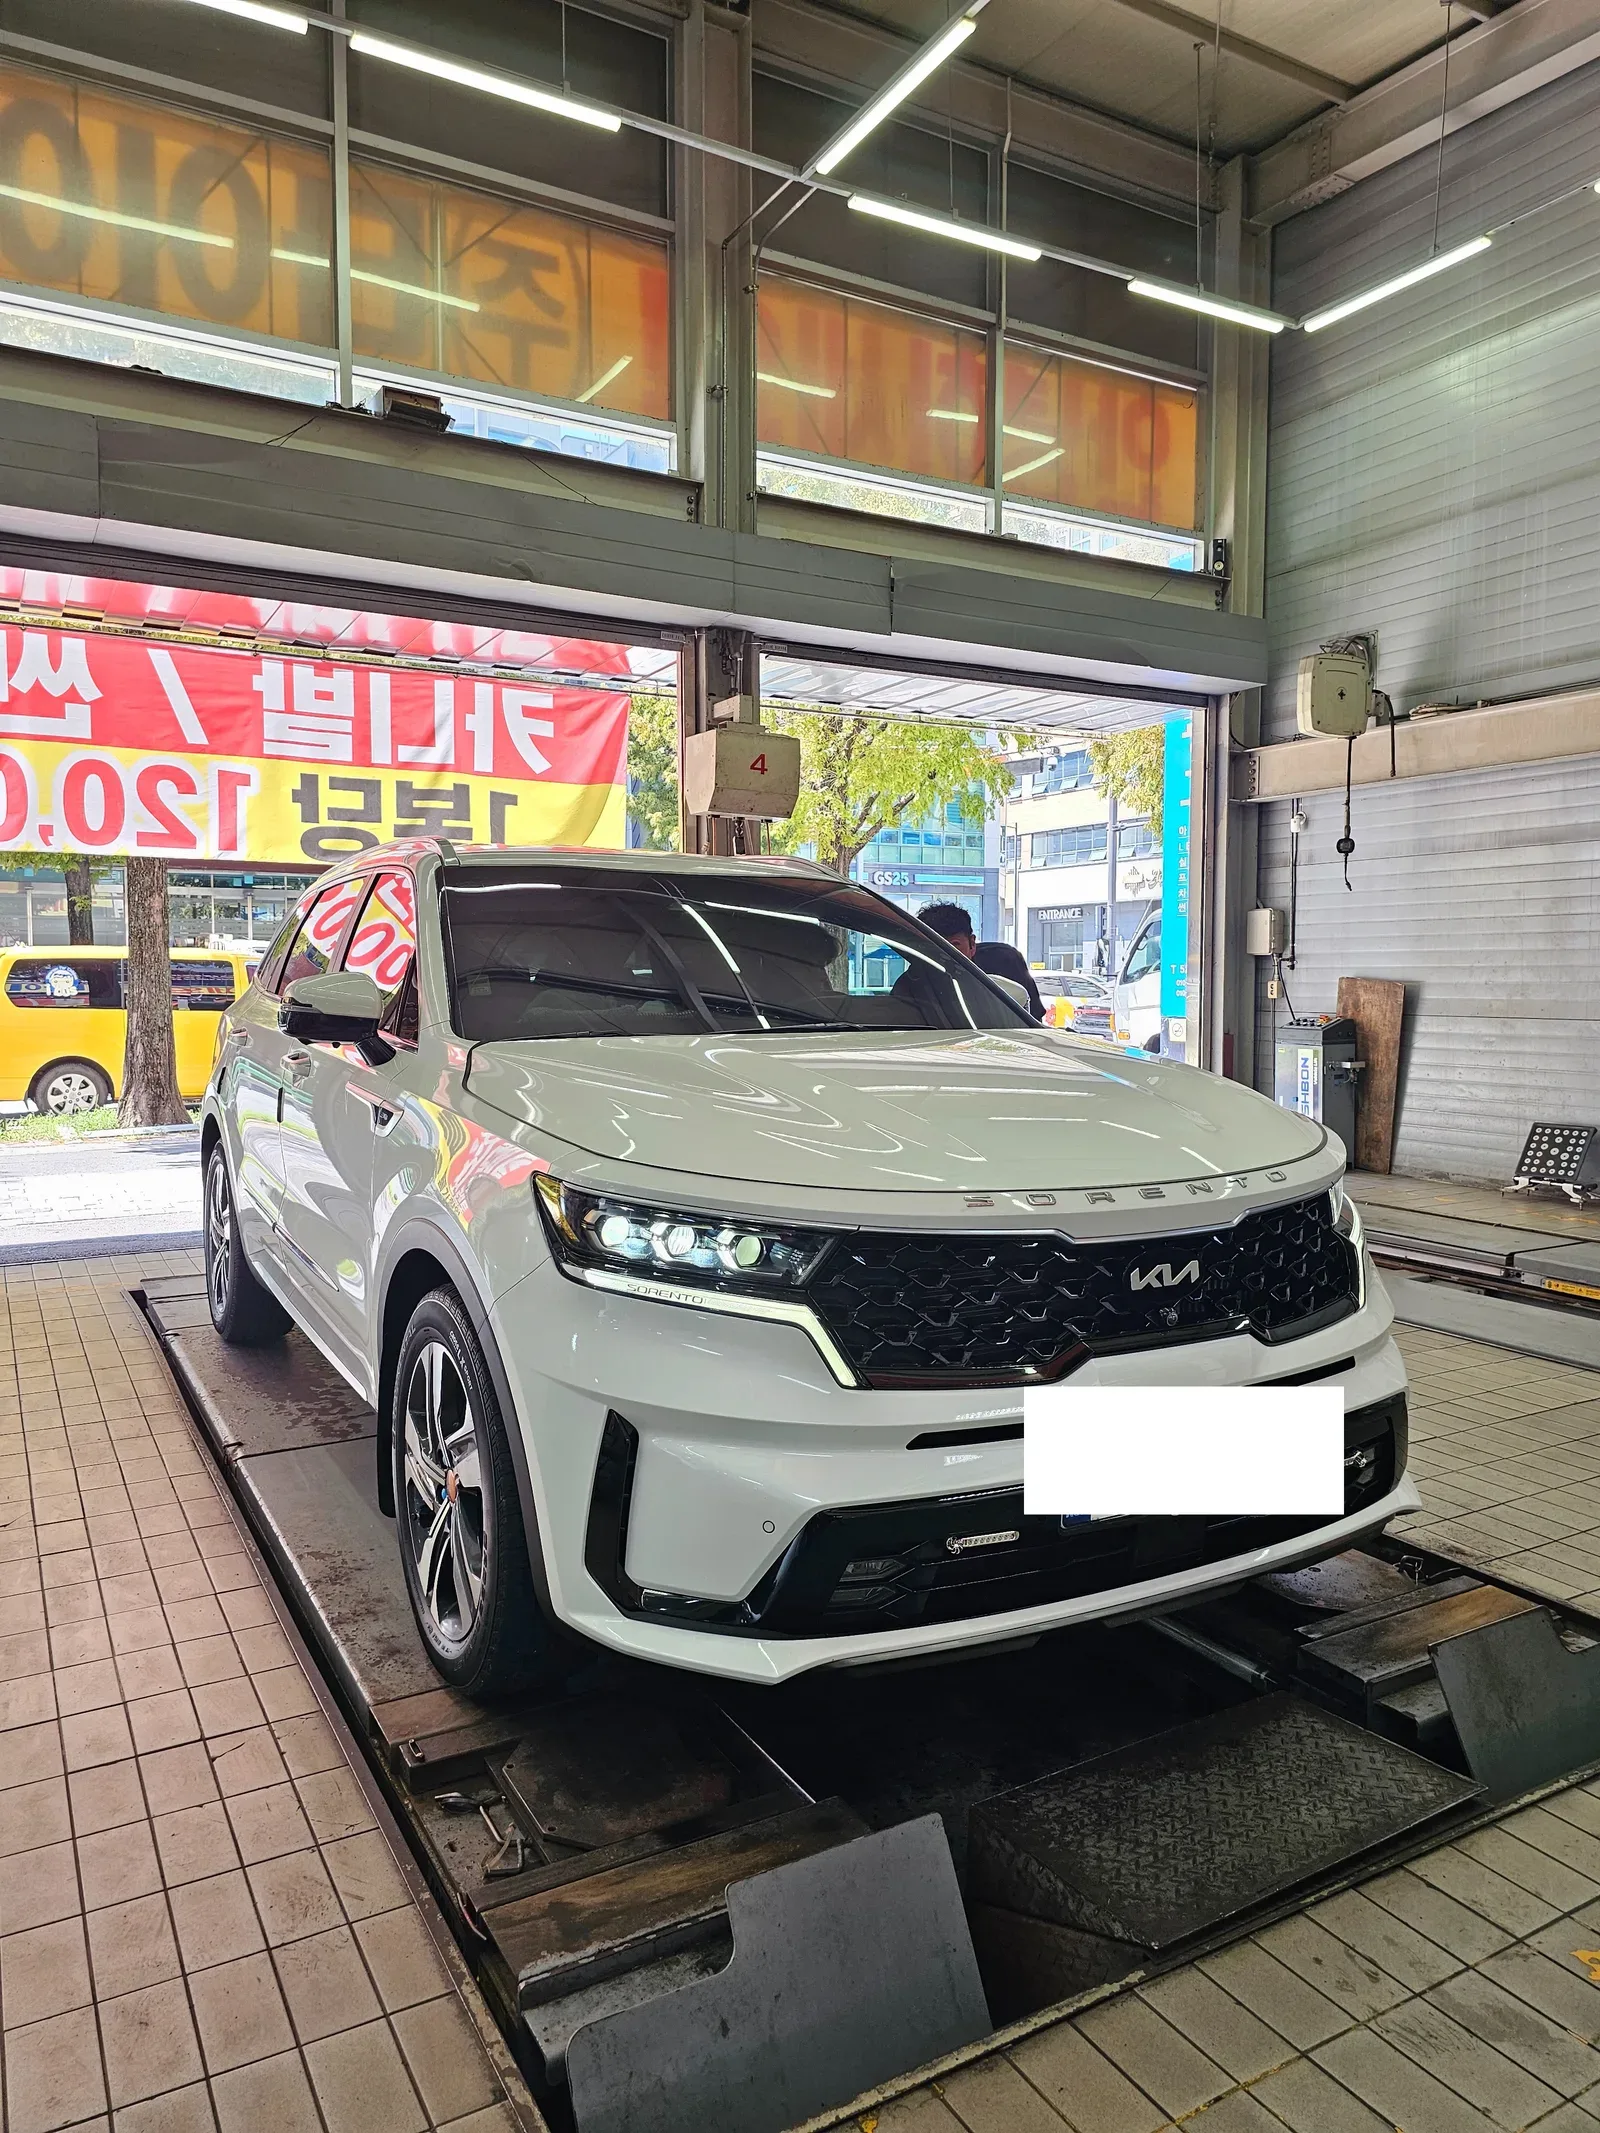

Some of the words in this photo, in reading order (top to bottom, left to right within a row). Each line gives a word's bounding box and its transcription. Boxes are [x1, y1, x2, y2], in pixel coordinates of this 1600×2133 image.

[749, 752, 769, 776] 4
[873, 870, 910, 887] GS25
[1037, 907, 1084, 920] ENTRANCE
[963, 1169, 1288, 1208] SORENTO
[626, 1283, 704, 1305] SORENTO
